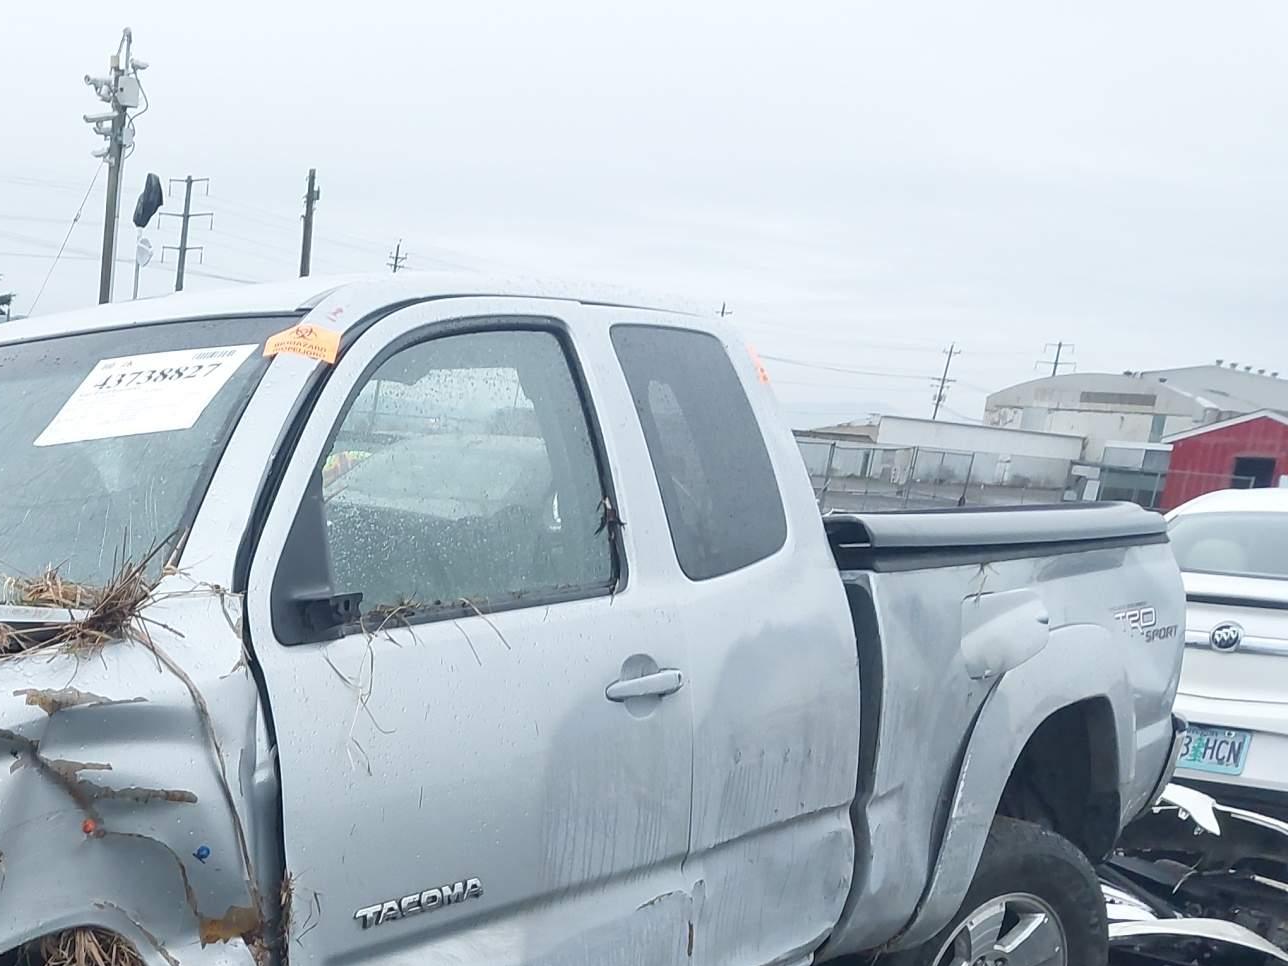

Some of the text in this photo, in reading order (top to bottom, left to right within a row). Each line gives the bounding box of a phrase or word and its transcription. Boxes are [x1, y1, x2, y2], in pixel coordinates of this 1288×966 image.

[94, 362, 223, 390] 43738827
[1114, 607, 1157, 634] TRD
[1145, 624, 1178, 643] SPORT
[353, 877, 484, 929] TACOMA
